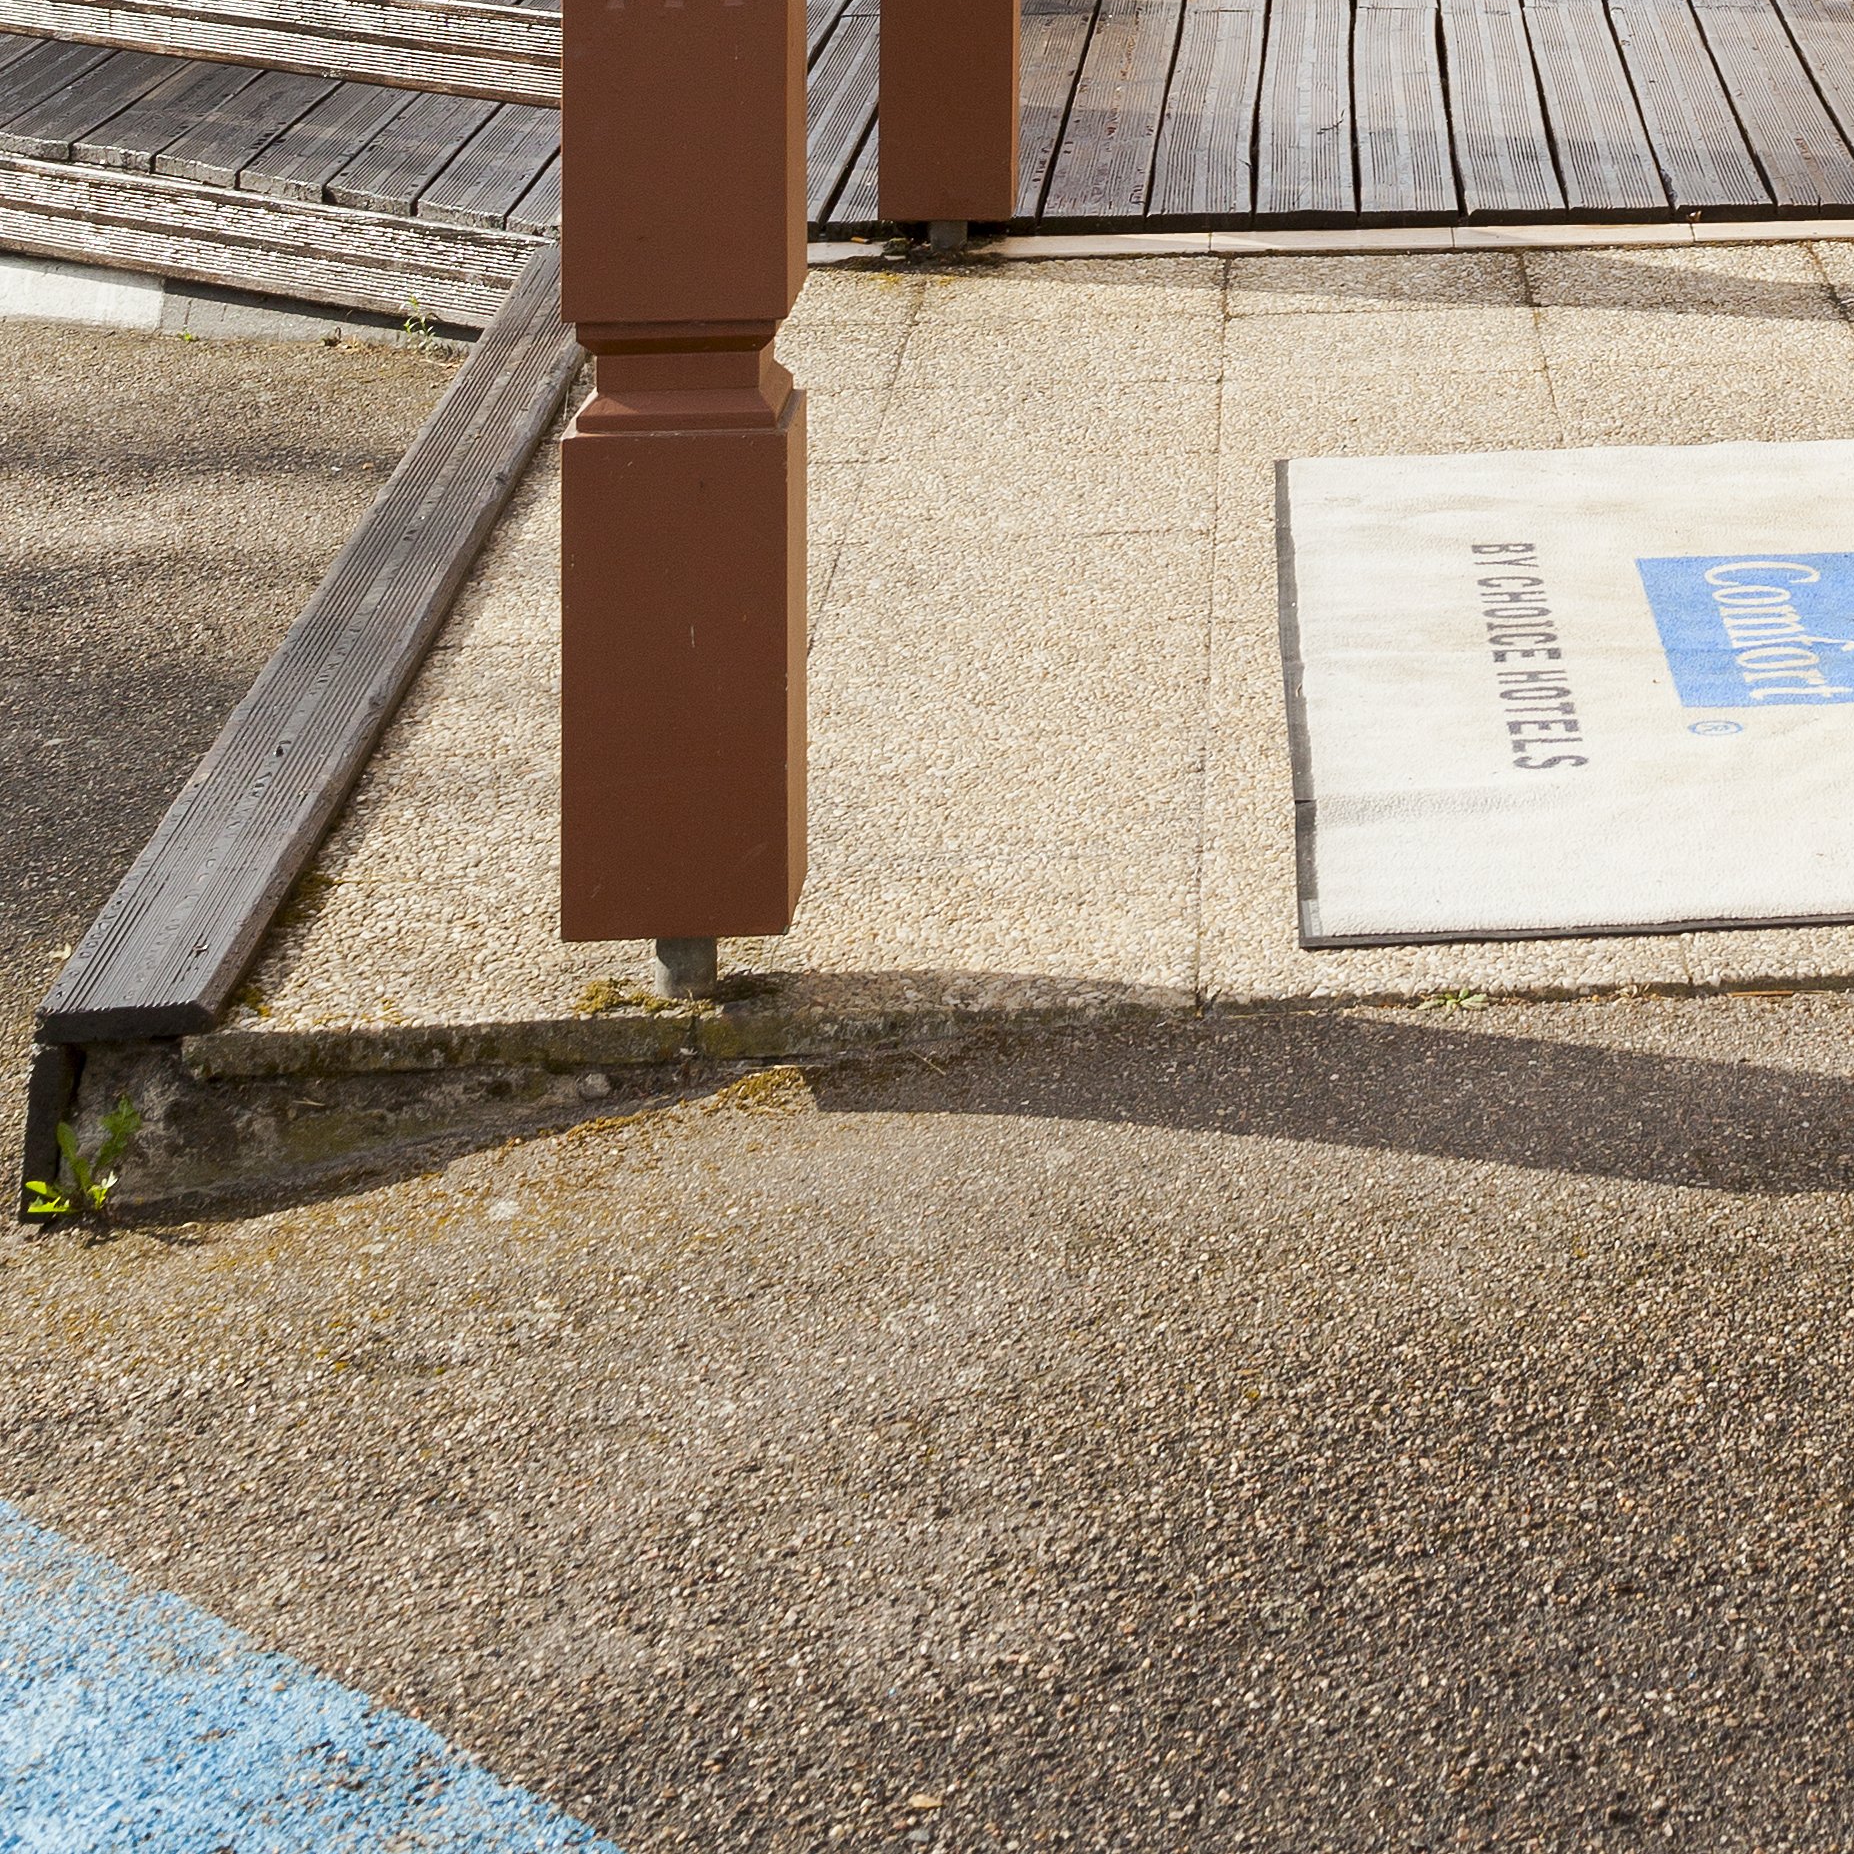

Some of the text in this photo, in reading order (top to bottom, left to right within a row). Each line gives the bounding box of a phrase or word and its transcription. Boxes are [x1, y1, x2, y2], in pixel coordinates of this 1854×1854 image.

[1471, 542, 1589, 770] BY CHOICE HOTELS
